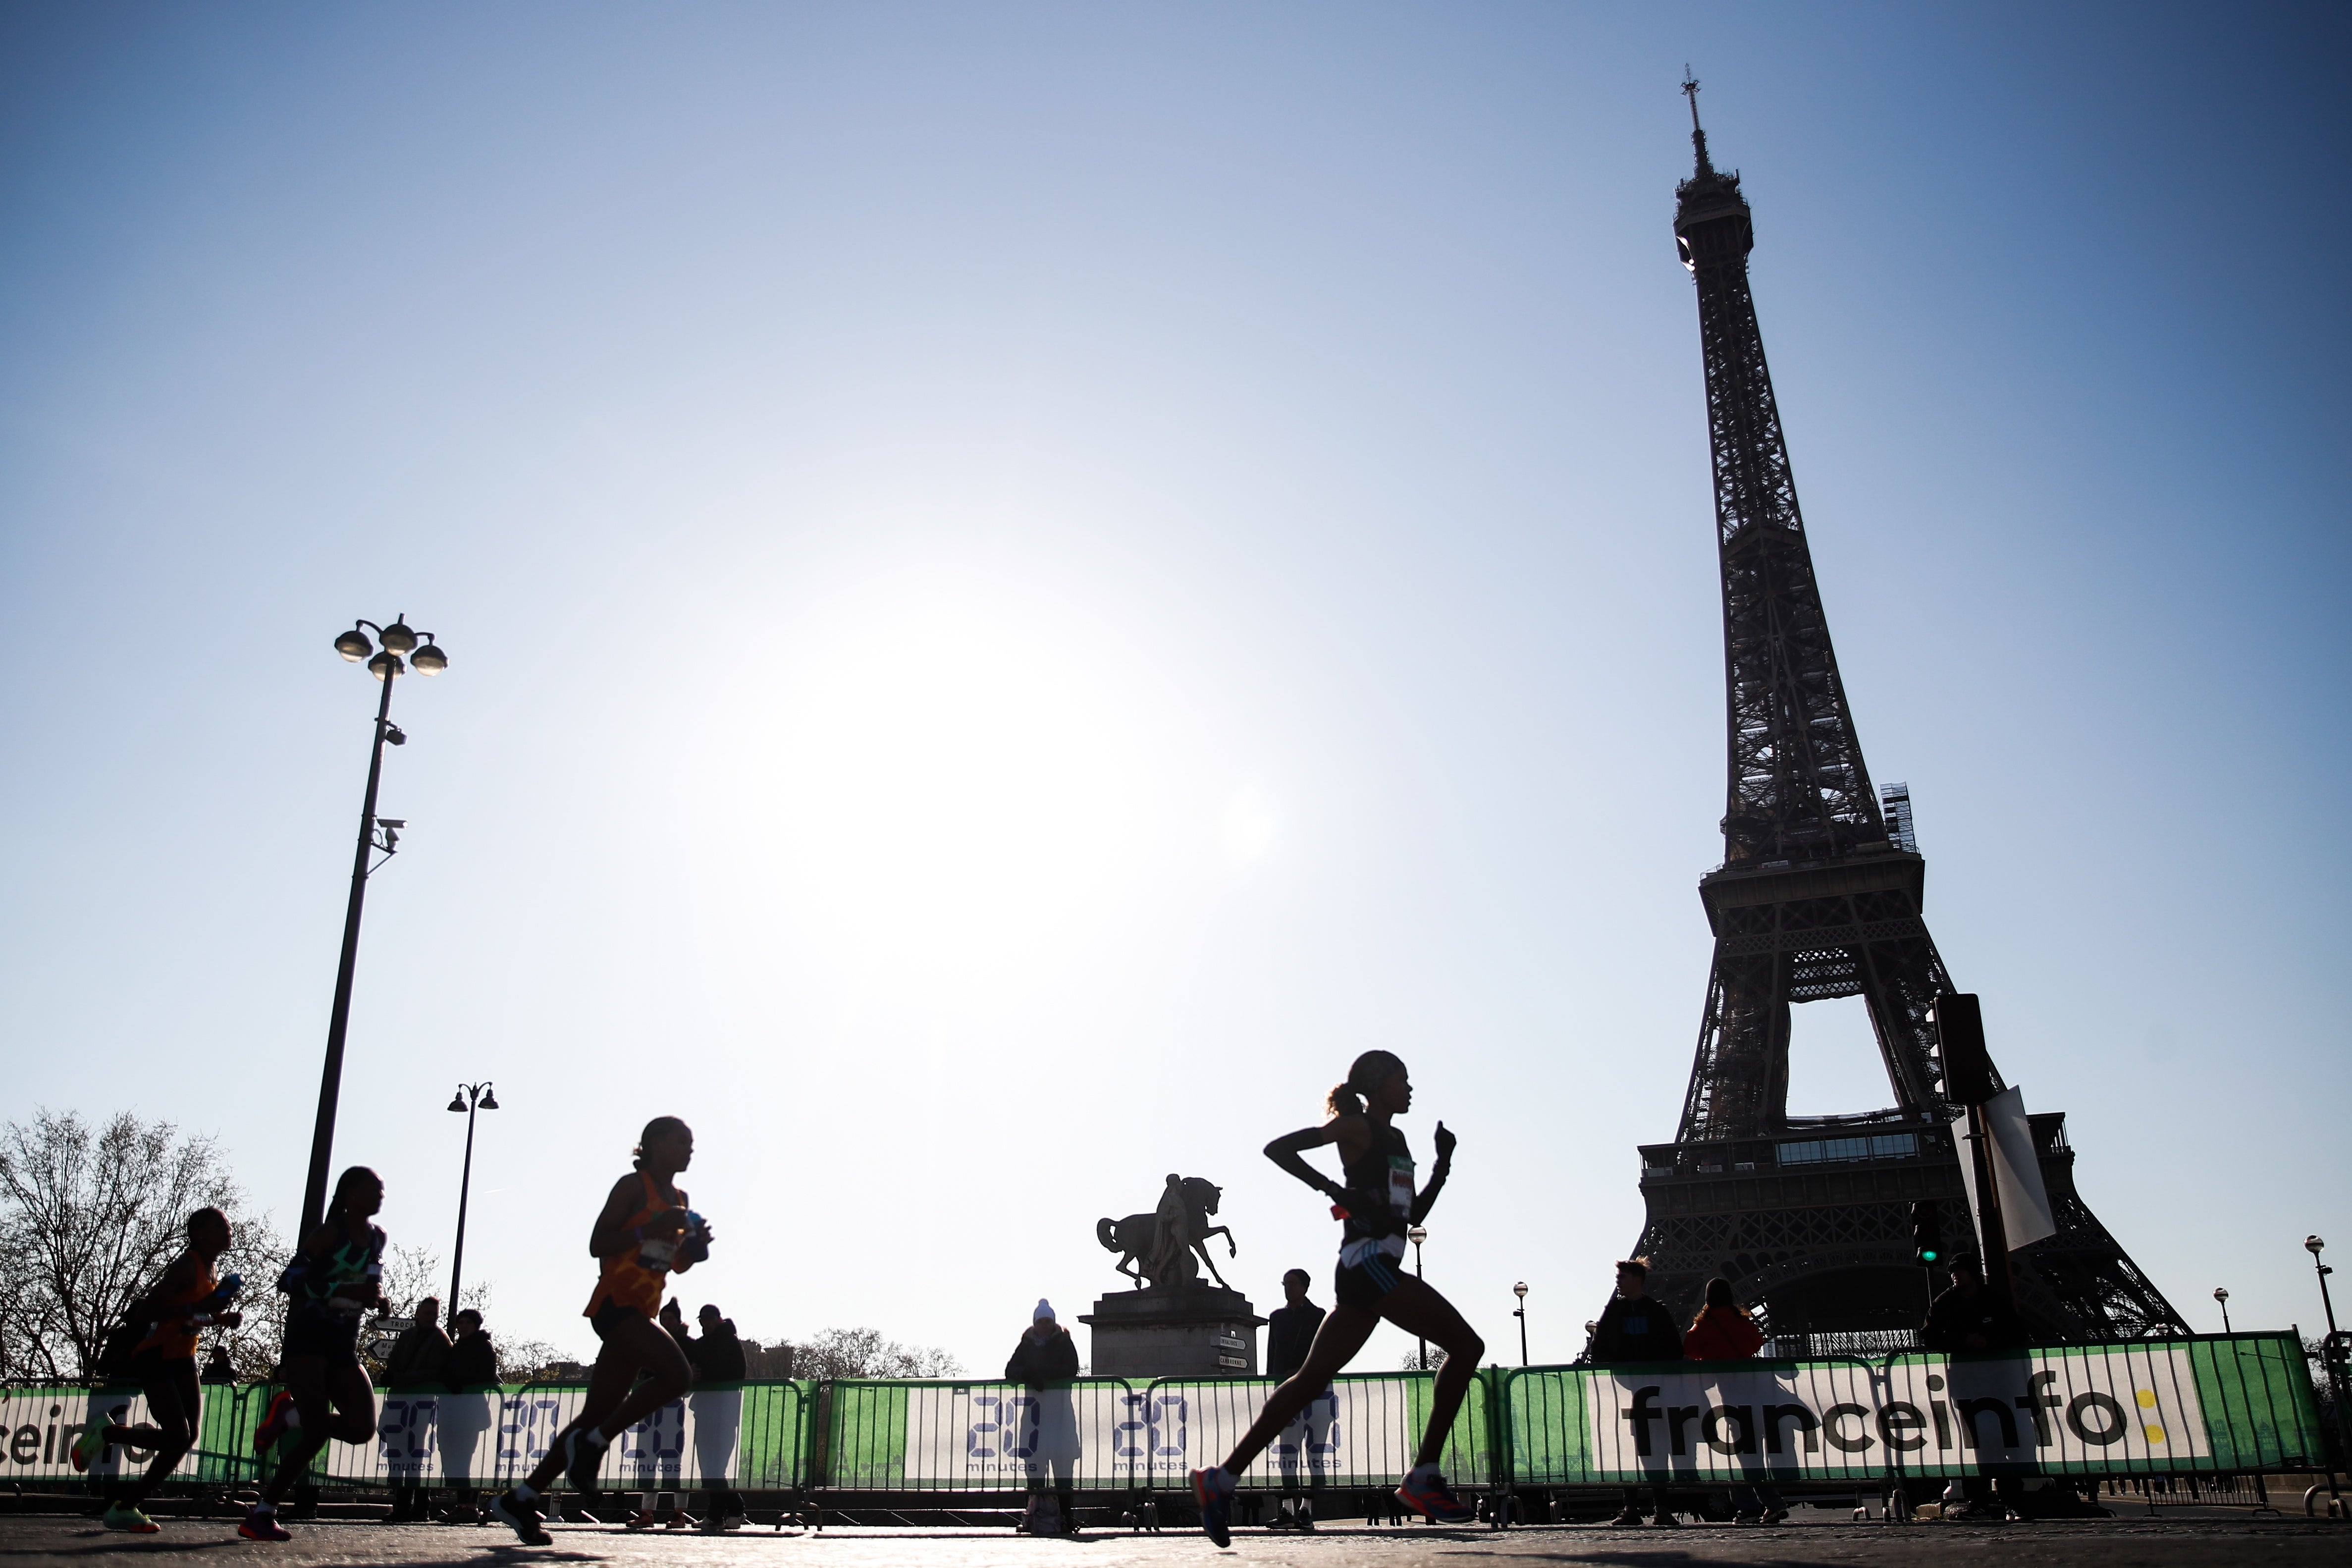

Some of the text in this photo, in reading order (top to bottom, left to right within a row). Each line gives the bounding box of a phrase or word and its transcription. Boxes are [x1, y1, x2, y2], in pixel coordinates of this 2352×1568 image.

[1220, 1357, 1242, 1366] CAMBRONNE
[379, 1400, 438, 1458] 20
[967, 1397, 1040, 1457] 20
[1114, 1396, 1188, 1456] 20
[376, 1461, 434, 1471] minutes
[619, 1461, 682, 1472] minutes
[966, 1460, 1038, 1472] minutes
[1114, 1460, 1188, 1471] minutes
[1267, 1458, 1342, 1468] minutes
